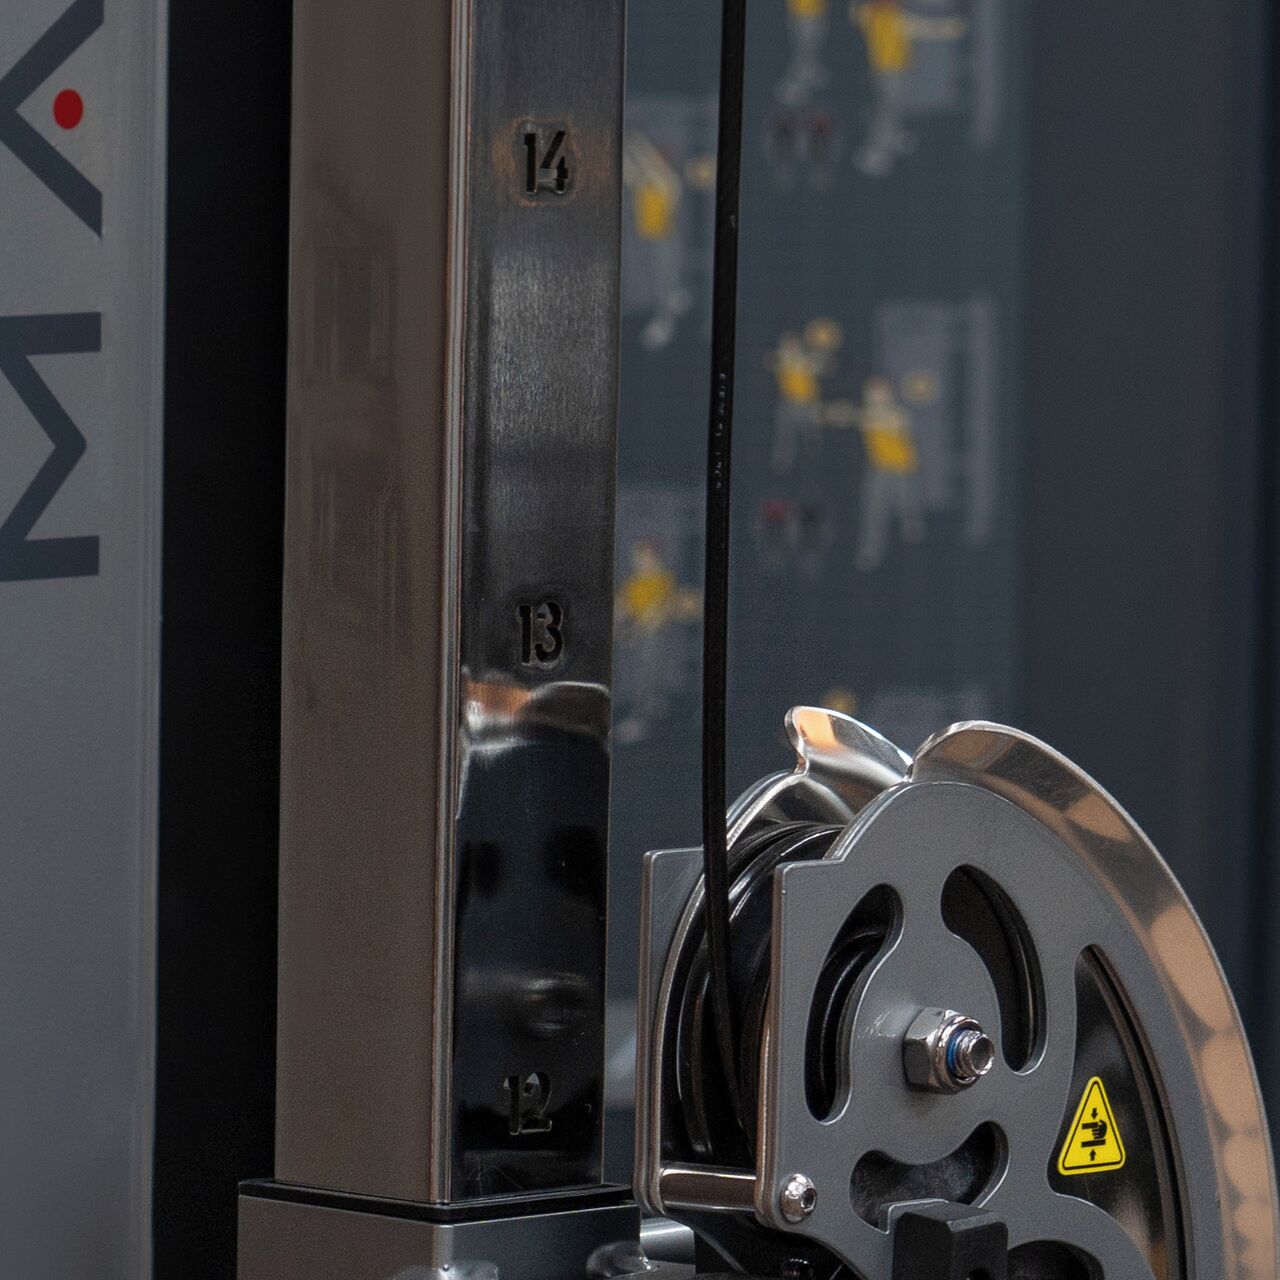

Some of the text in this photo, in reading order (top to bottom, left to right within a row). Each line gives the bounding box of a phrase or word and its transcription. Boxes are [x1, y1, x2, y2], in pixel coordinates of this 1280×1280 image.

[522, 129, 569, 194] 14
[517, 601, 564, 667] 13
[503, 1070, 553, 1136] 12
